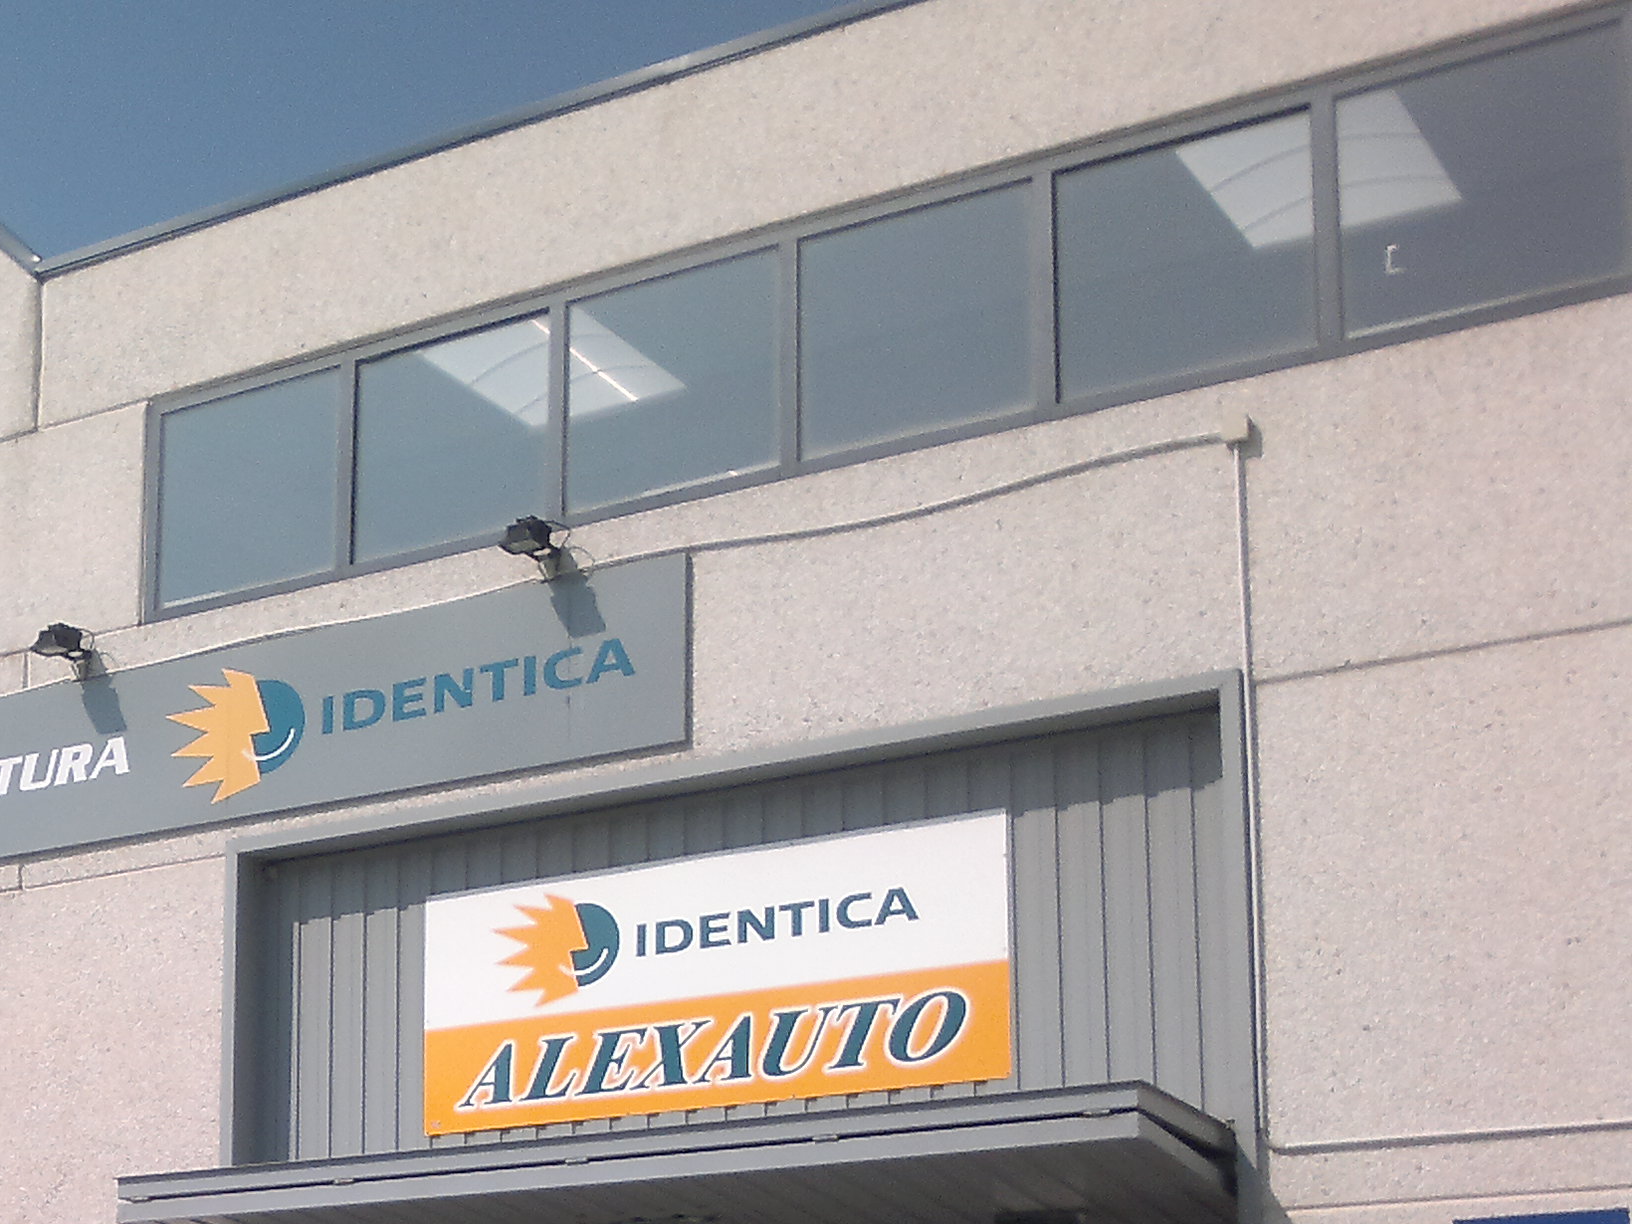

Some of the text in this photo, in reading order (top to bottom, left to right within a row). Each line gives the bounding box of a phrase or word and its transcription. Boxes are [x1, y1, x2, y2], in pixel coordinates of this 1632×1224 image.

[320, 637, 636, 736] IDENTICA
[636, 886, 920, 958] IDENTICA
[458, 990, 967, 1108] ALEXAUTO
